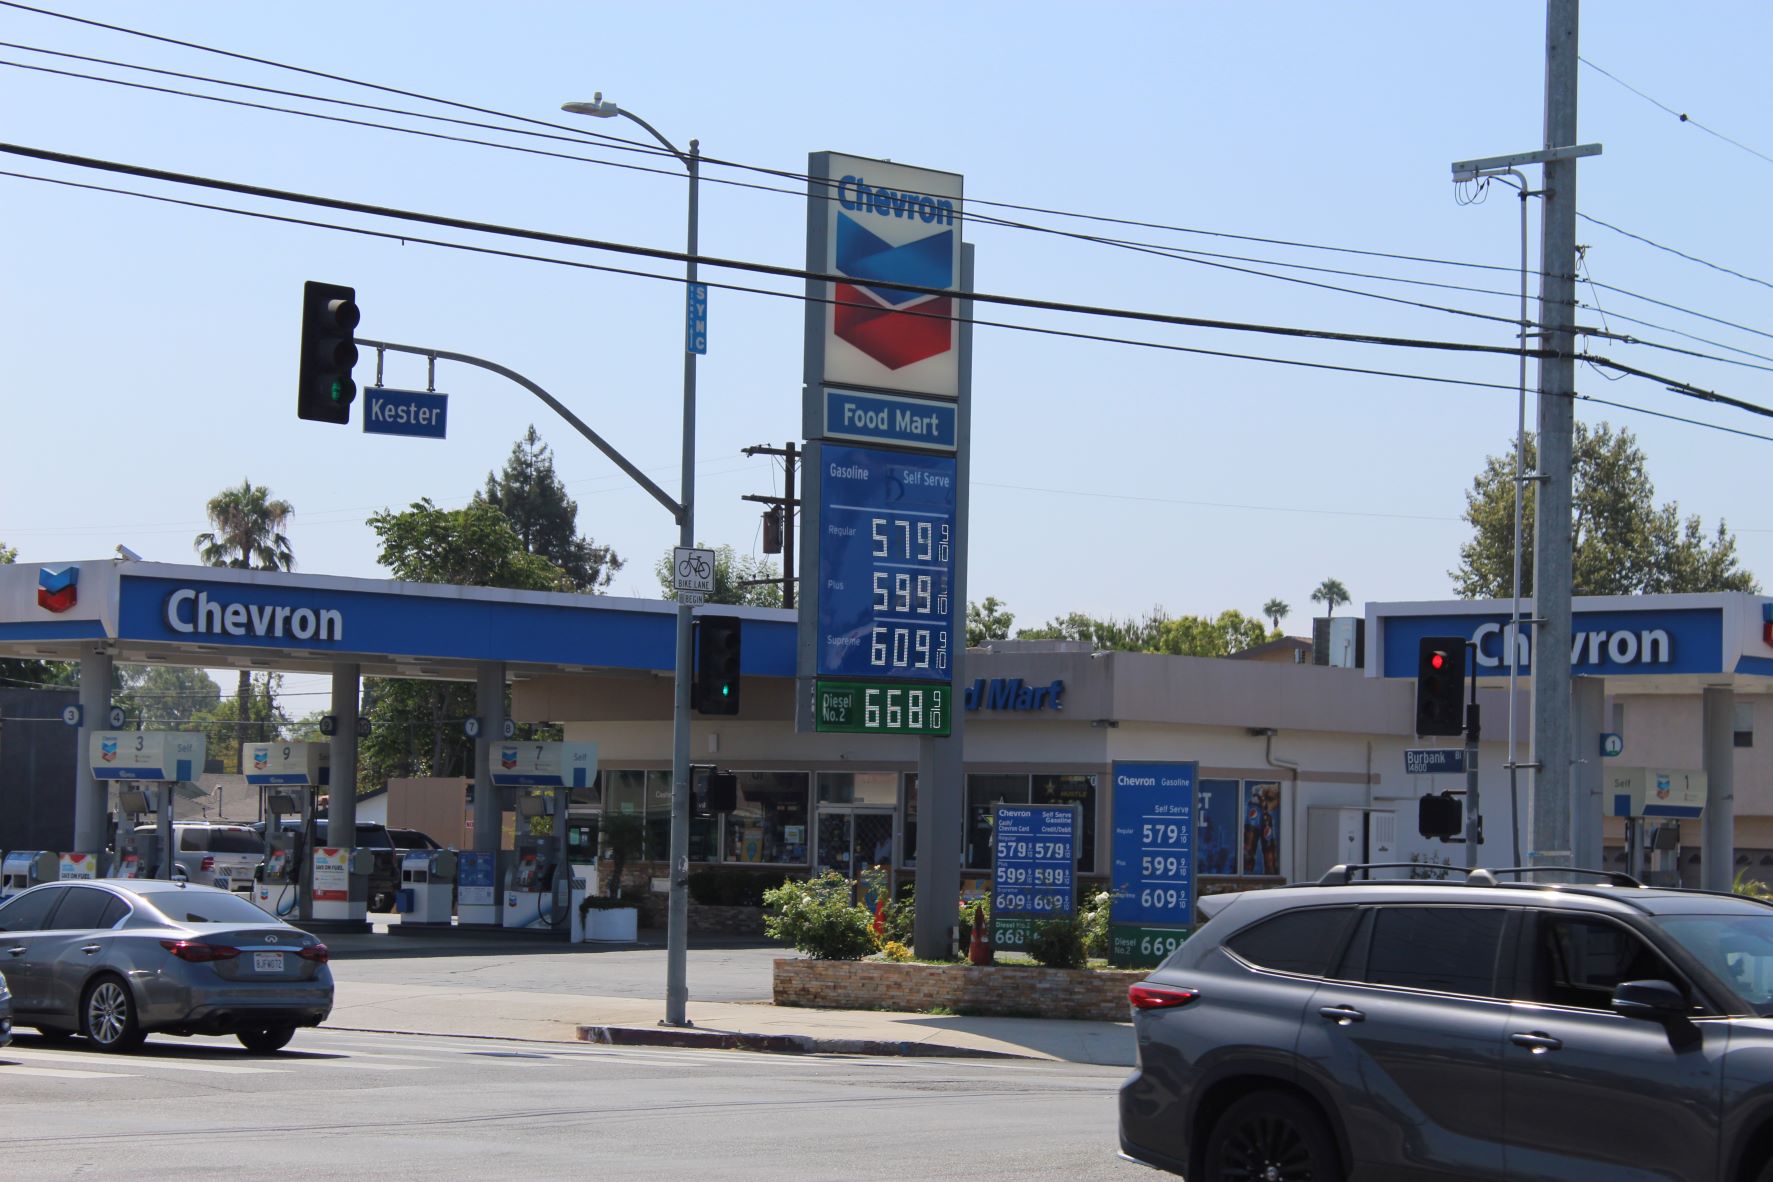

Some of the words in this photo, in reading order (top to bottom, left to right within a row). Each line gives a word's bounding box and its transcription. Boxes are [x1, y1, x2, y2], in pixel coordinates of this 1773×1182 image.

[837, 175, 953, 226] Chevron
[695, 287, 705, 350] SYNC
[371, 398, 440, 426] Kester
[844, 403, 888, 430] Food
[895, 409, 939, 436] Mart
[830, 463, 869, 480] Gasoline
[903, 470, 921, 485] Self
[923, 472, 950, 487] Serve
[828, 524, 856, 536] Regular
[872, 518, 932, 561] 579
[678, 580, 692, 588] BIKE
[693, 581, 709, 590] LANE
[827, 579, 844, 590] Plus
[685, 595, 703, 604] BEGIN
[873, 572, 931, 614] 599
[167, 589, 342, 641] Chevron
[827, 634, 860, 647] Supreme
[871, 627, 930, 669] 609
[1472, 622, 1669, 667] Chvron
[822, 693, 852, 708] Diesel
[986, 678, 1064, 711] Mart
[822, 708, 846, 722] No.2
[865, 688, 923, 729] 668
[135, 735, 144, 752] 3
[177, 743, 193, 753] Self
[283, 746, 291, 760] 9
[535, 745, 543, 760] 7
[573, 752, 587, 762] Self
[1407, 751, 1446, 764] Burbank
[1407, 763, 1428, 772] 14800
[1118, 775, 1155, 786] Chevron
[1161, 778, 1190, 787] Gasoline
[1614, 778, 1631, 788] Self
[998, 809, 1031, 817] Chevron
[1154, 804, 1168, 813] Self
[1169, 805, 1189, 814] Serve
[1142, 824, 1178, 844] 579
[997, 842, 1027, 857] 579
[1035, 843, 1064, 858] 579
[1142, 856, 1177, 876] 599
[997, 867, 1026, 883] 599
[1034, 869, 1064, 884] 599
[996, 894, 1025, 909] 609
[1034, 895, 1063, 910] 609
[1141, 889, 1177, 909] 609
[1114, 937, 1136, 947] Diesel
[1141, 936, 1176, 956] 669
[1114, 946, 1131, 955] No.2
